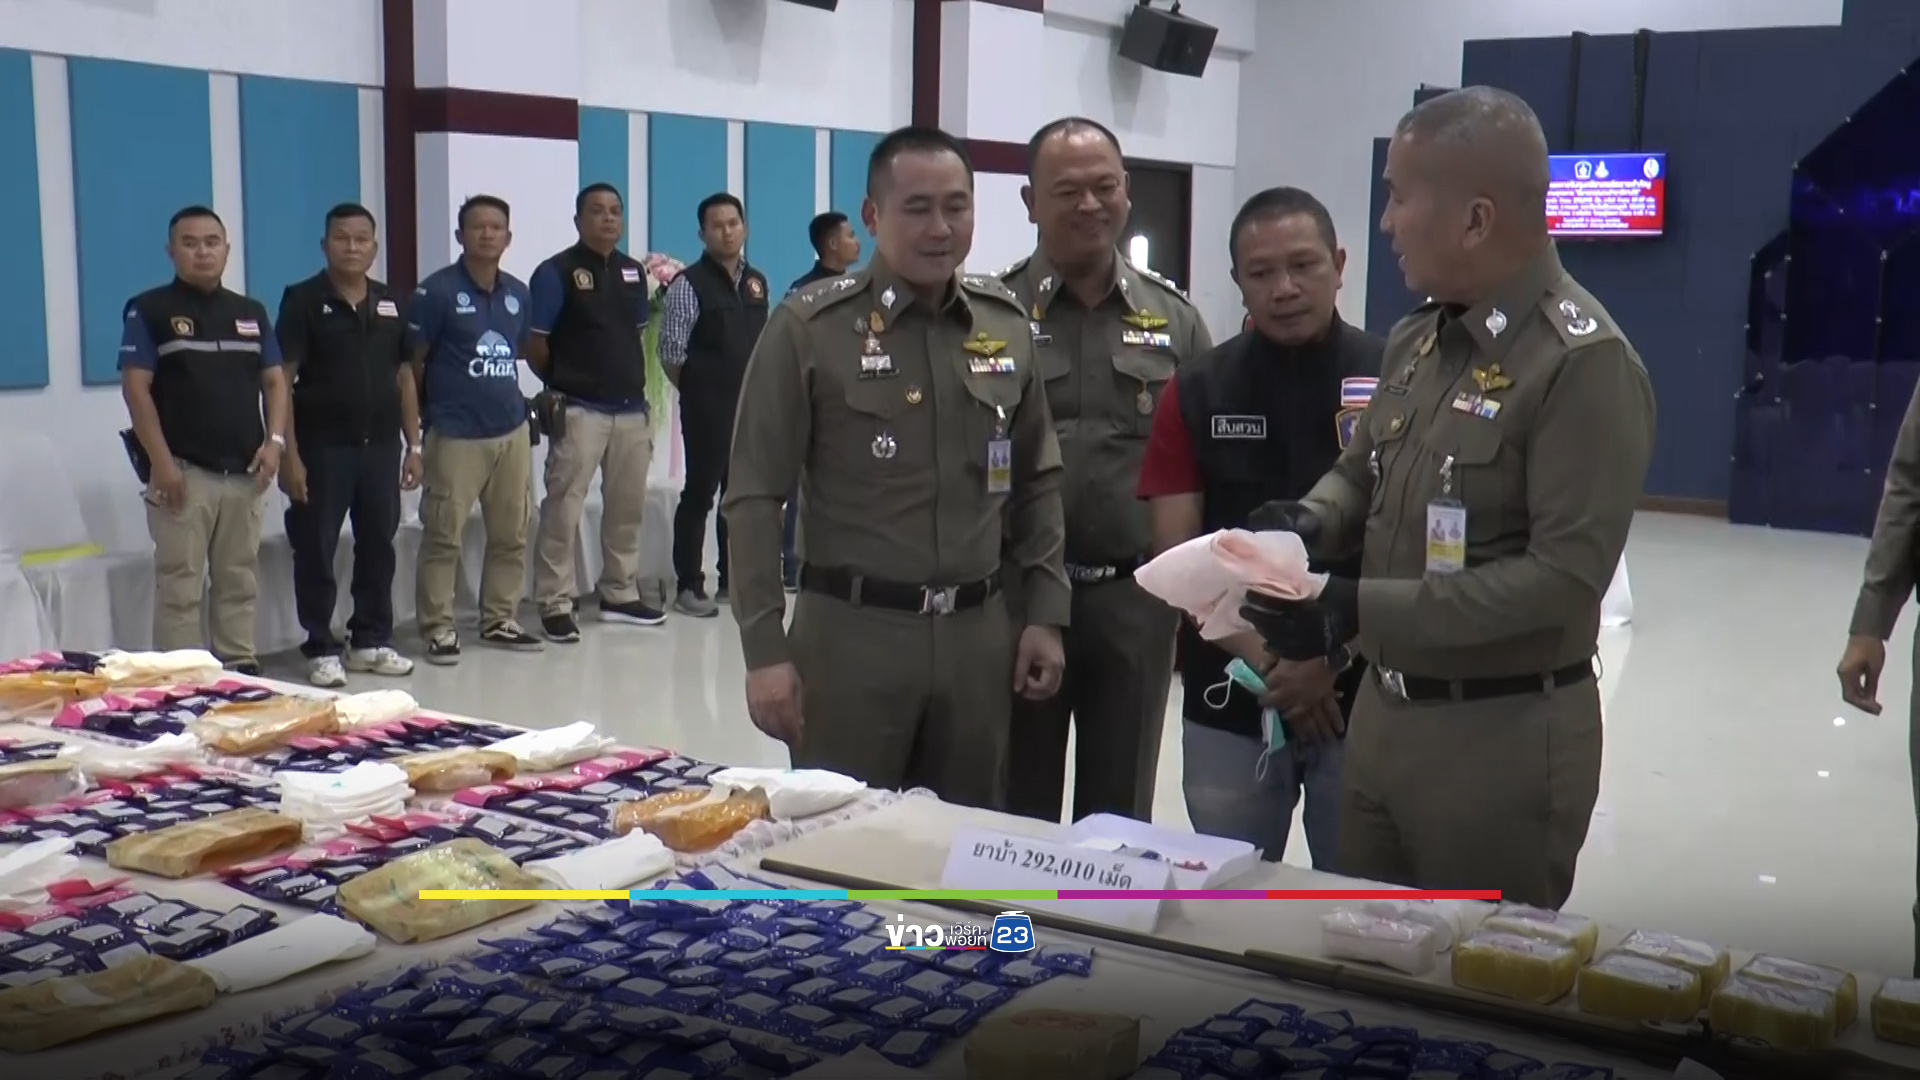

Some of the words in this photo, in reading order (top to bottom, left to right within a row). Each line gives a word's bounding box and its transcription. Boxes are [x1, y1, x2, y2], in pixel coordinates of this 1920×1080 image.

[972, 838, 1018, 866] ยาบ้า
[1020, 848, 1096, 882] 292,010
[1099, 862, 1132, 890] เม็ด
